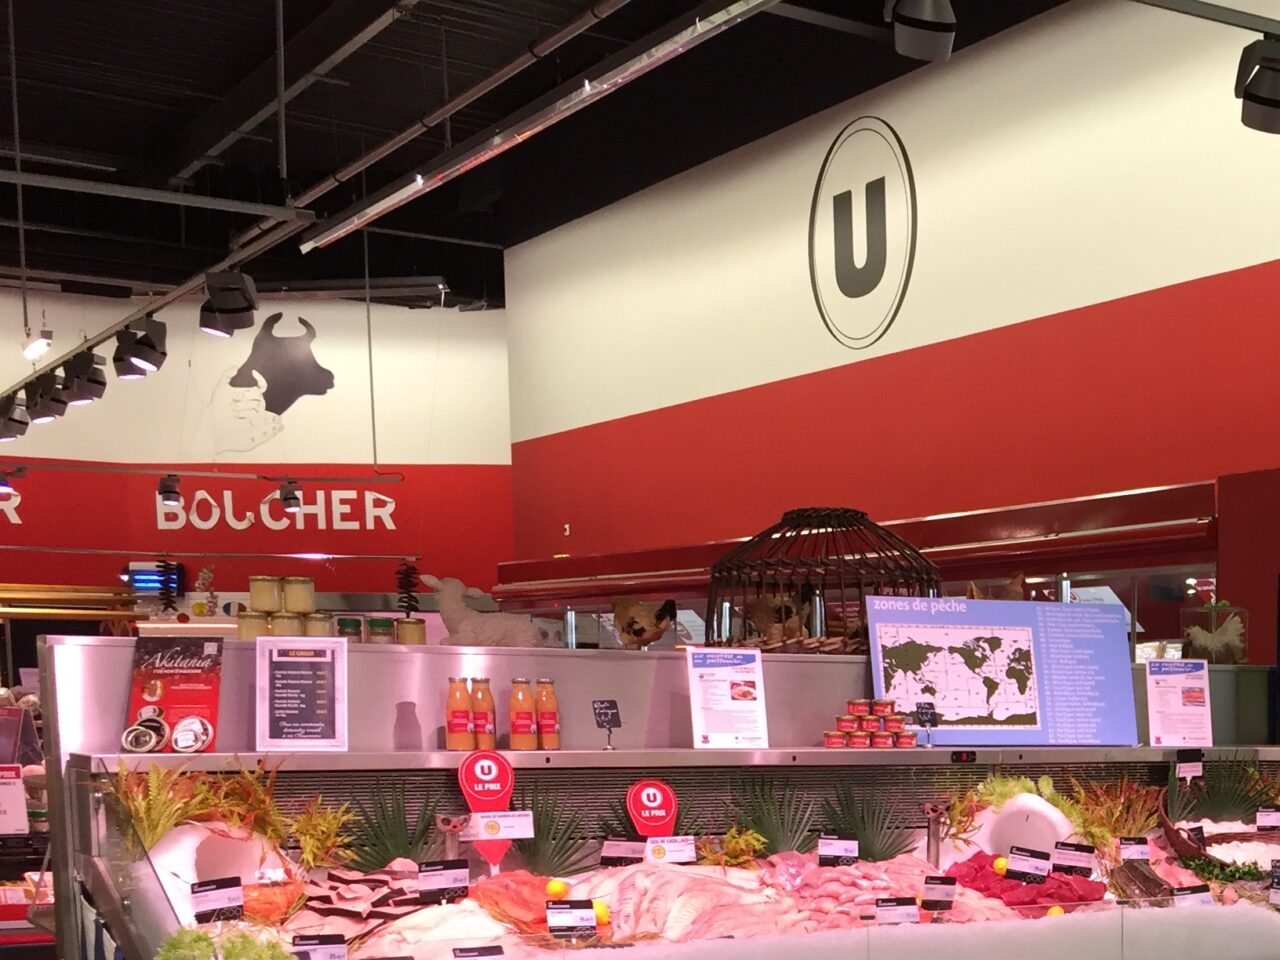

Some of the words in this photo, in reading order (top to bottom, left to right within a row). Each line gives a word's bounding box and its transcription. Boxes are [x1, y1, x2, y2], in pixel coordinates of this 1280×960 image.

[833, 175, 887, 299] U
[873, 600, 910, 611] zones
[912, 600, 928, 611] de
[931, 599, 967, 615] pêche
[474, 783, 483, 791] LE
[651, 809, 666, 817] PRIX
